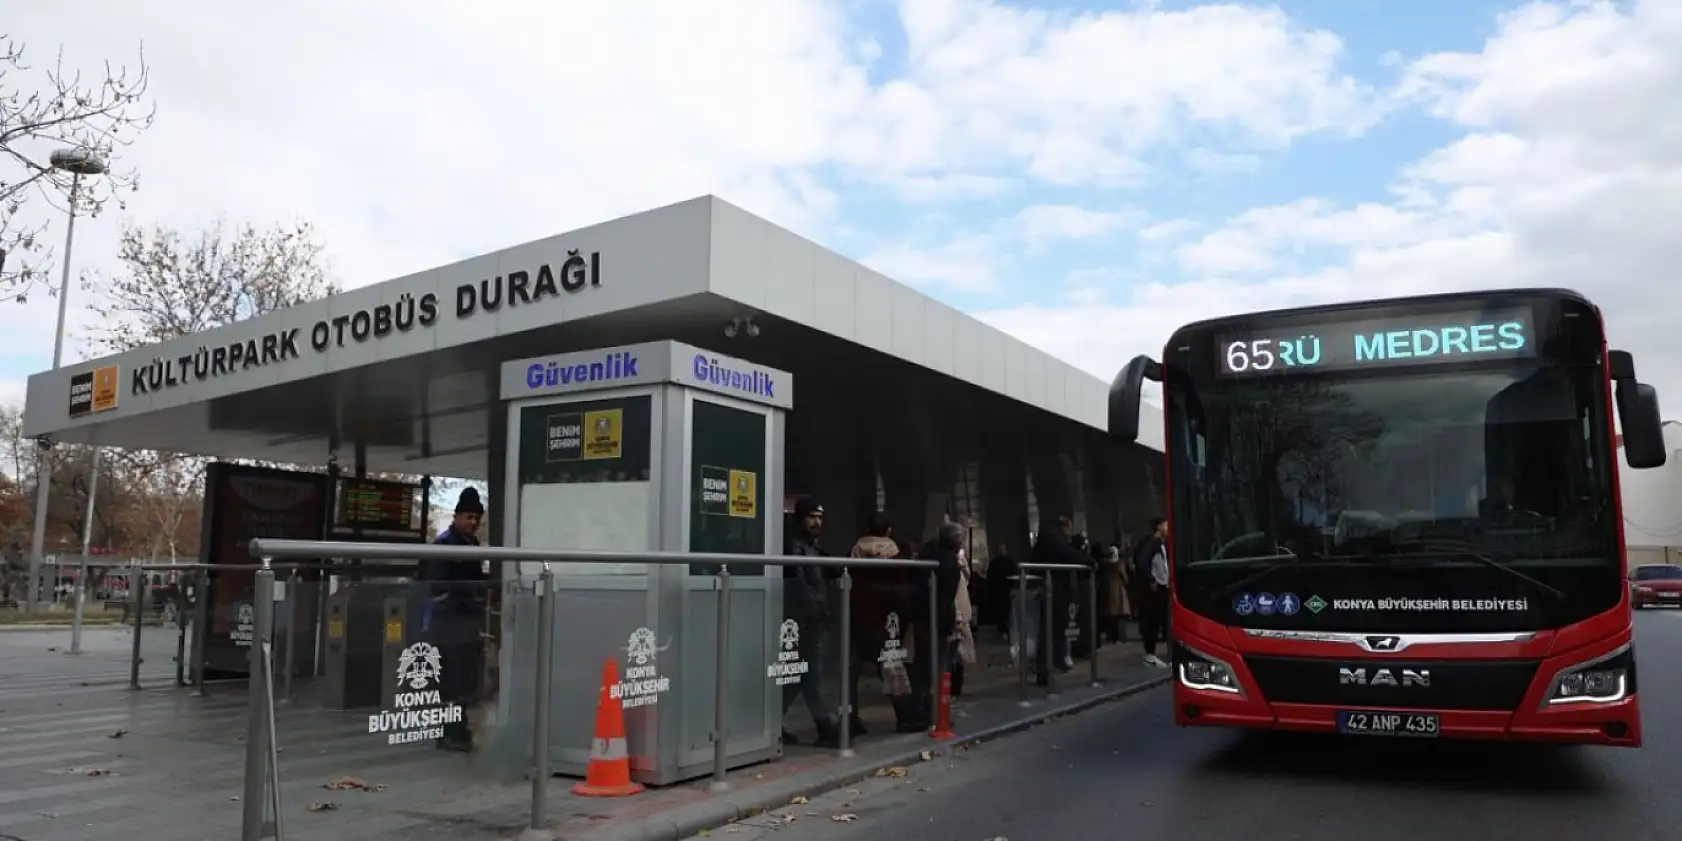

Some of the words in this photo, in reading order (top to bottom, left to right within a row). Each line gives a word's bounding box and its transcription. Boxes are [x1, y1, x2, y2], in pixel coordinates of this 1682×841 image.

[132, 327, 299, 395] KÜLTÜRPARK
[311, 292, 438, 351] OTOBÜS
[456, 248, 600, 318] DURAĞI
[1355, 322, 1525, 361] MEDRES
[1226, 340, 1274, 372] 65
[526, 351, 638, 389] Güvenlik
[693, 353, 774, 398] Güvenlik
[1333, 599, 1375, 610] KONYA
[1377, 597, 1449, 612] BÜYÜKŞEHİR
[1452, 597, 1528, 611] BELEDİYESİ
[626, 665, 656, 679] KONYA
[1339, 668, 1430, 687] MAN
[395, 690, 441, 708] KONYA
[609, 674, 670, 699] BÜYÜKŞEHİR
[368, 703, 462, 733] BÜYÜKŞEHİR
[1347, 714, 1367, 729] 42
[1372, 715, 1400, 730] ANP
[1406, 716, 1436, 732] 435
[388, 725, 444, 745] BELEDİYESİ
